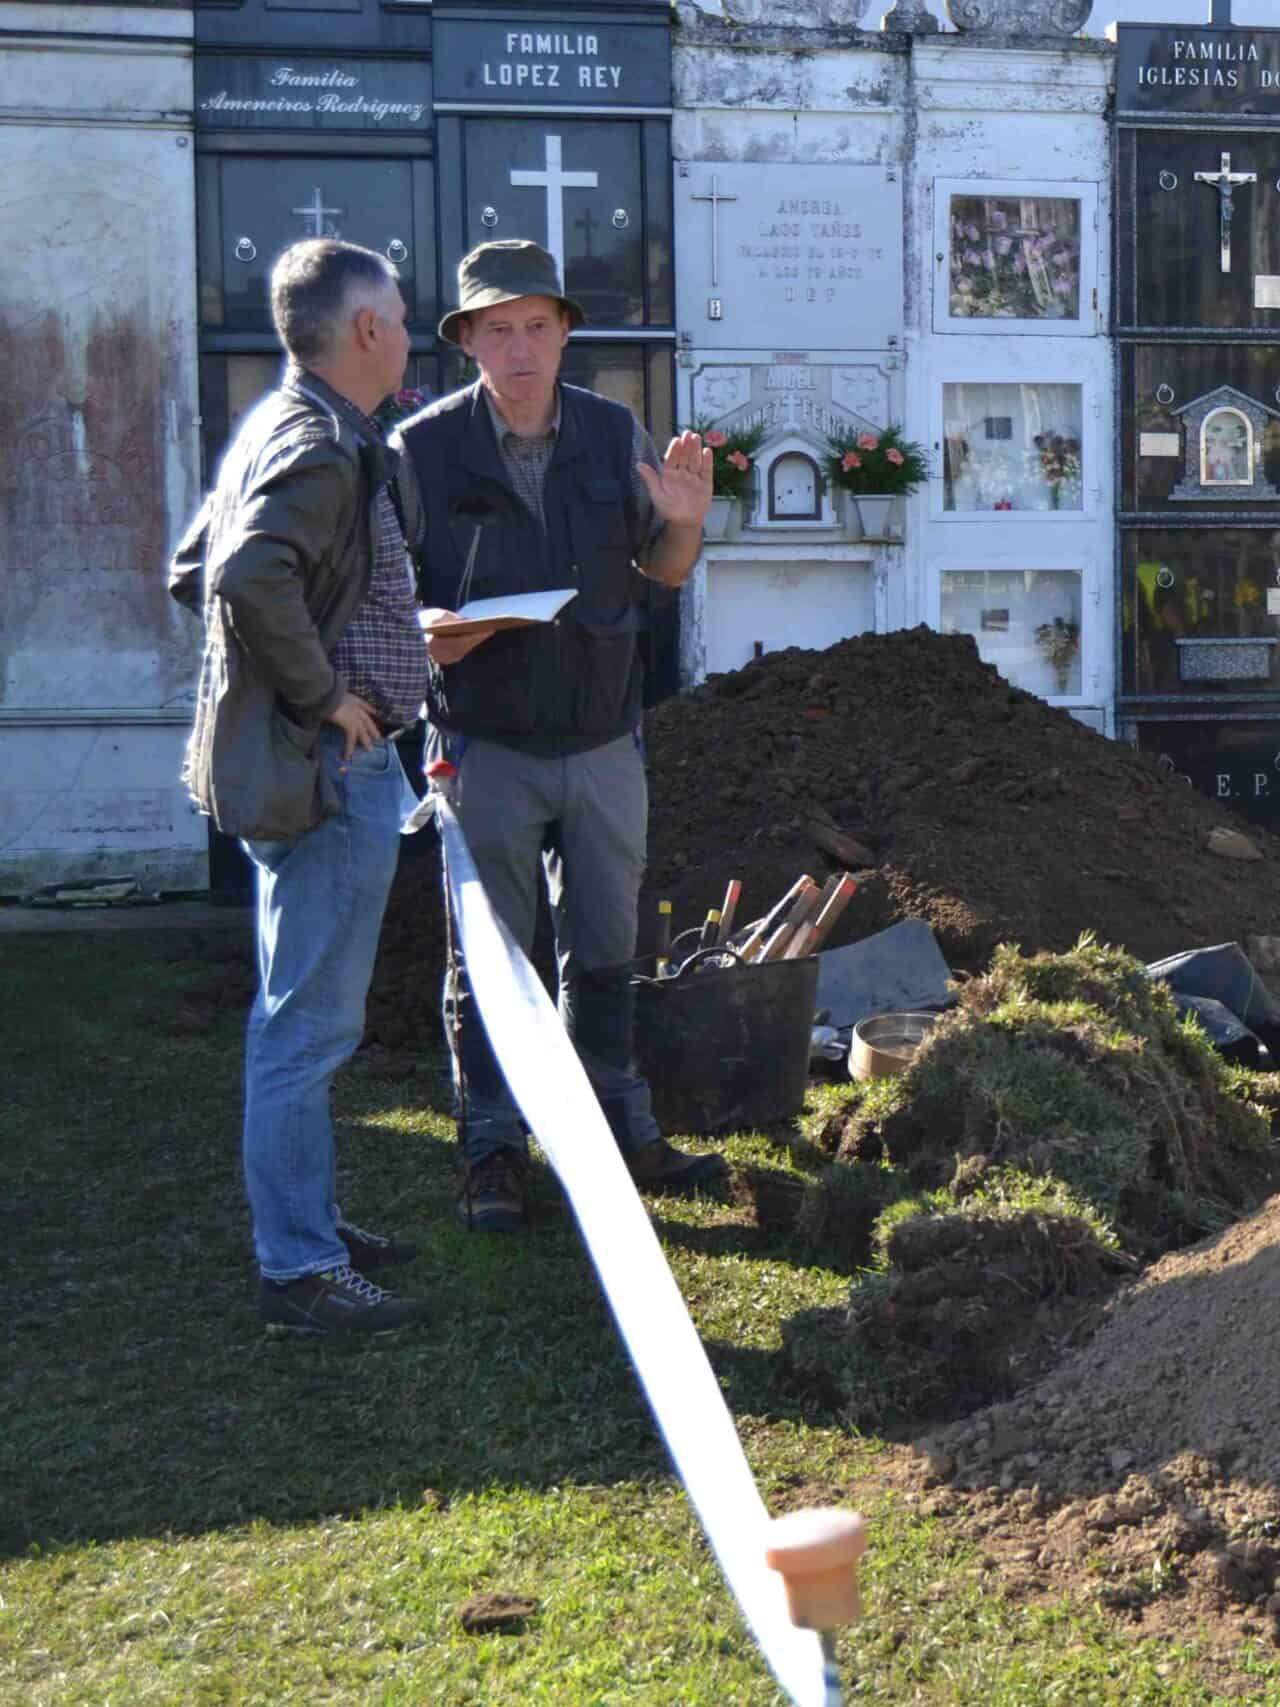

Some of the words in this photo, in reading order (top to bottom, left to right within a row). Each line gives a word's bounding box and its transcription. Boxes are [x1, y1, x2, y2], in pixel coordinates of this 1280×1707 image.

[506, 33, 600, 55] FAMILIA
[1173, 40, 1259, 61] FAMILIA
[270, 67, 360, 88] Familia
[483, 63, 561, 86] LOPEZ
[578, 65, 622, 88] REY
[1137, 66, 1238, 88] IGLESIAS
[200, 91, 314, 112] Ameneiros
